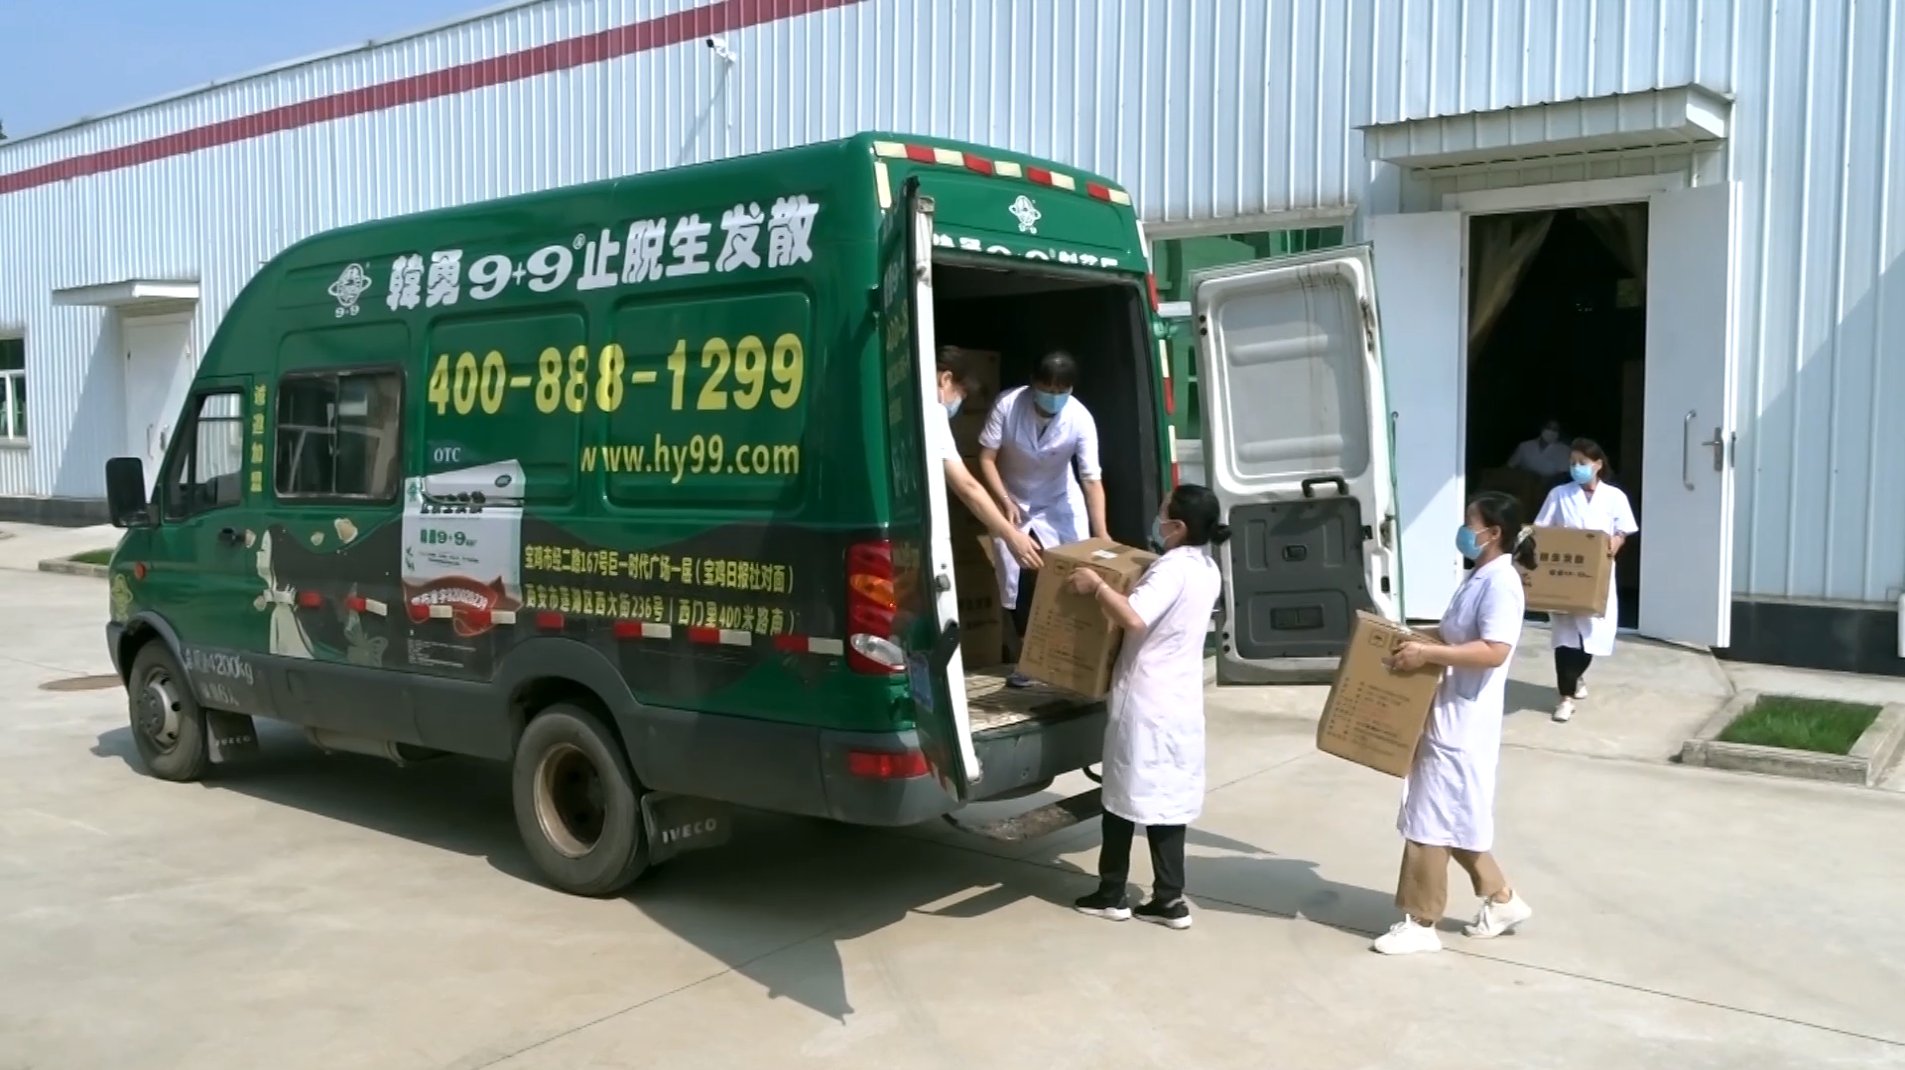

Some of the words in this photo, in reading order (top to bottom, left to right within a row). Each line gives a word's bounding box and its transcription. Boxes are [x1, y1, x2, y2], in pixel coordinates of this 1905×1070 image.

[428, 332, 805, 415] 400-888-1299
[433, 446, 462, 462] OTC
[580, 433, 800, 484] www.hy99.com
[662, 817, 718, 844] IVECO
